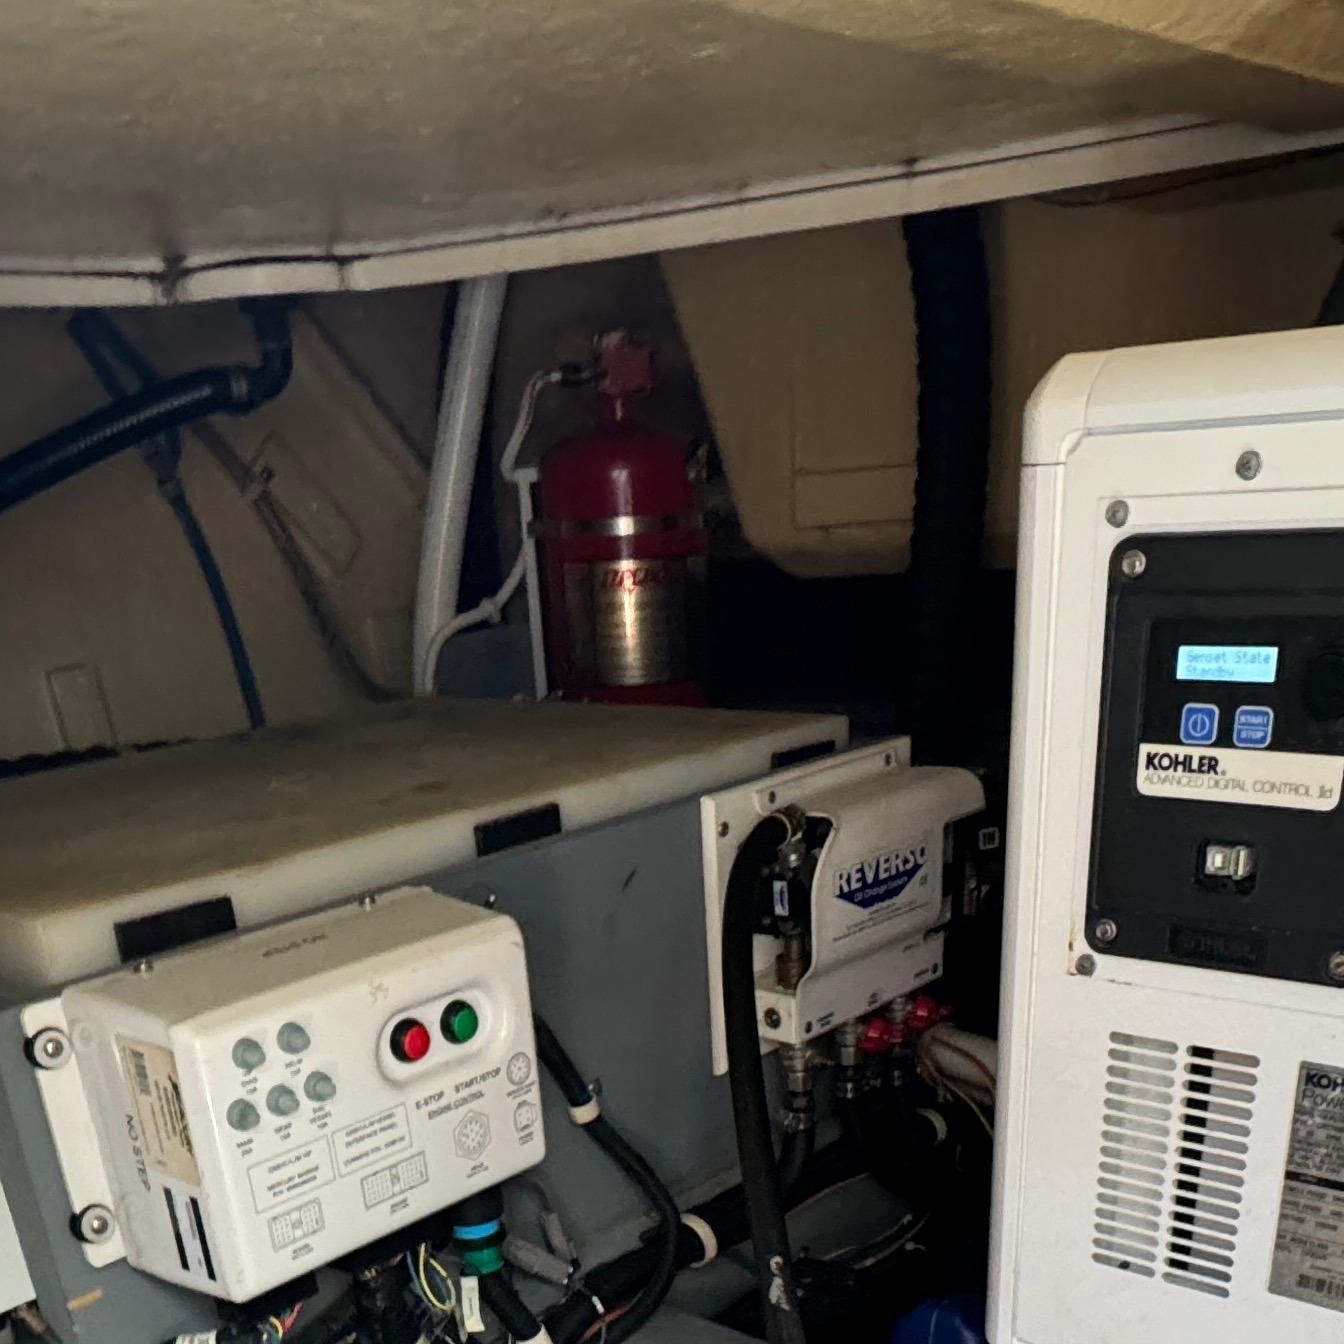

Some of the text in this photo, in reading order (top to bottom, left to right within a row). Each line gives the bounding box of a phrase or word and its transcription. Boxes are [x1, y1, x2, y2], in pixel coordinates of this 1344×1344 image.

[1234, 651, 1272, 664] State
[1145, 751, 1220, 776] KOHLER
[1142, 774, 1205, 789] ADVANCED
[1207, 778, 1249, 793] DIGITAL
[1252, 780, 1313, 797] CONTROL
[834, 846, 929, 897] REVERSO
[415, 1090, 446, 1110] E-STOP
[125, 1113, 152, 1193] NO STEP
